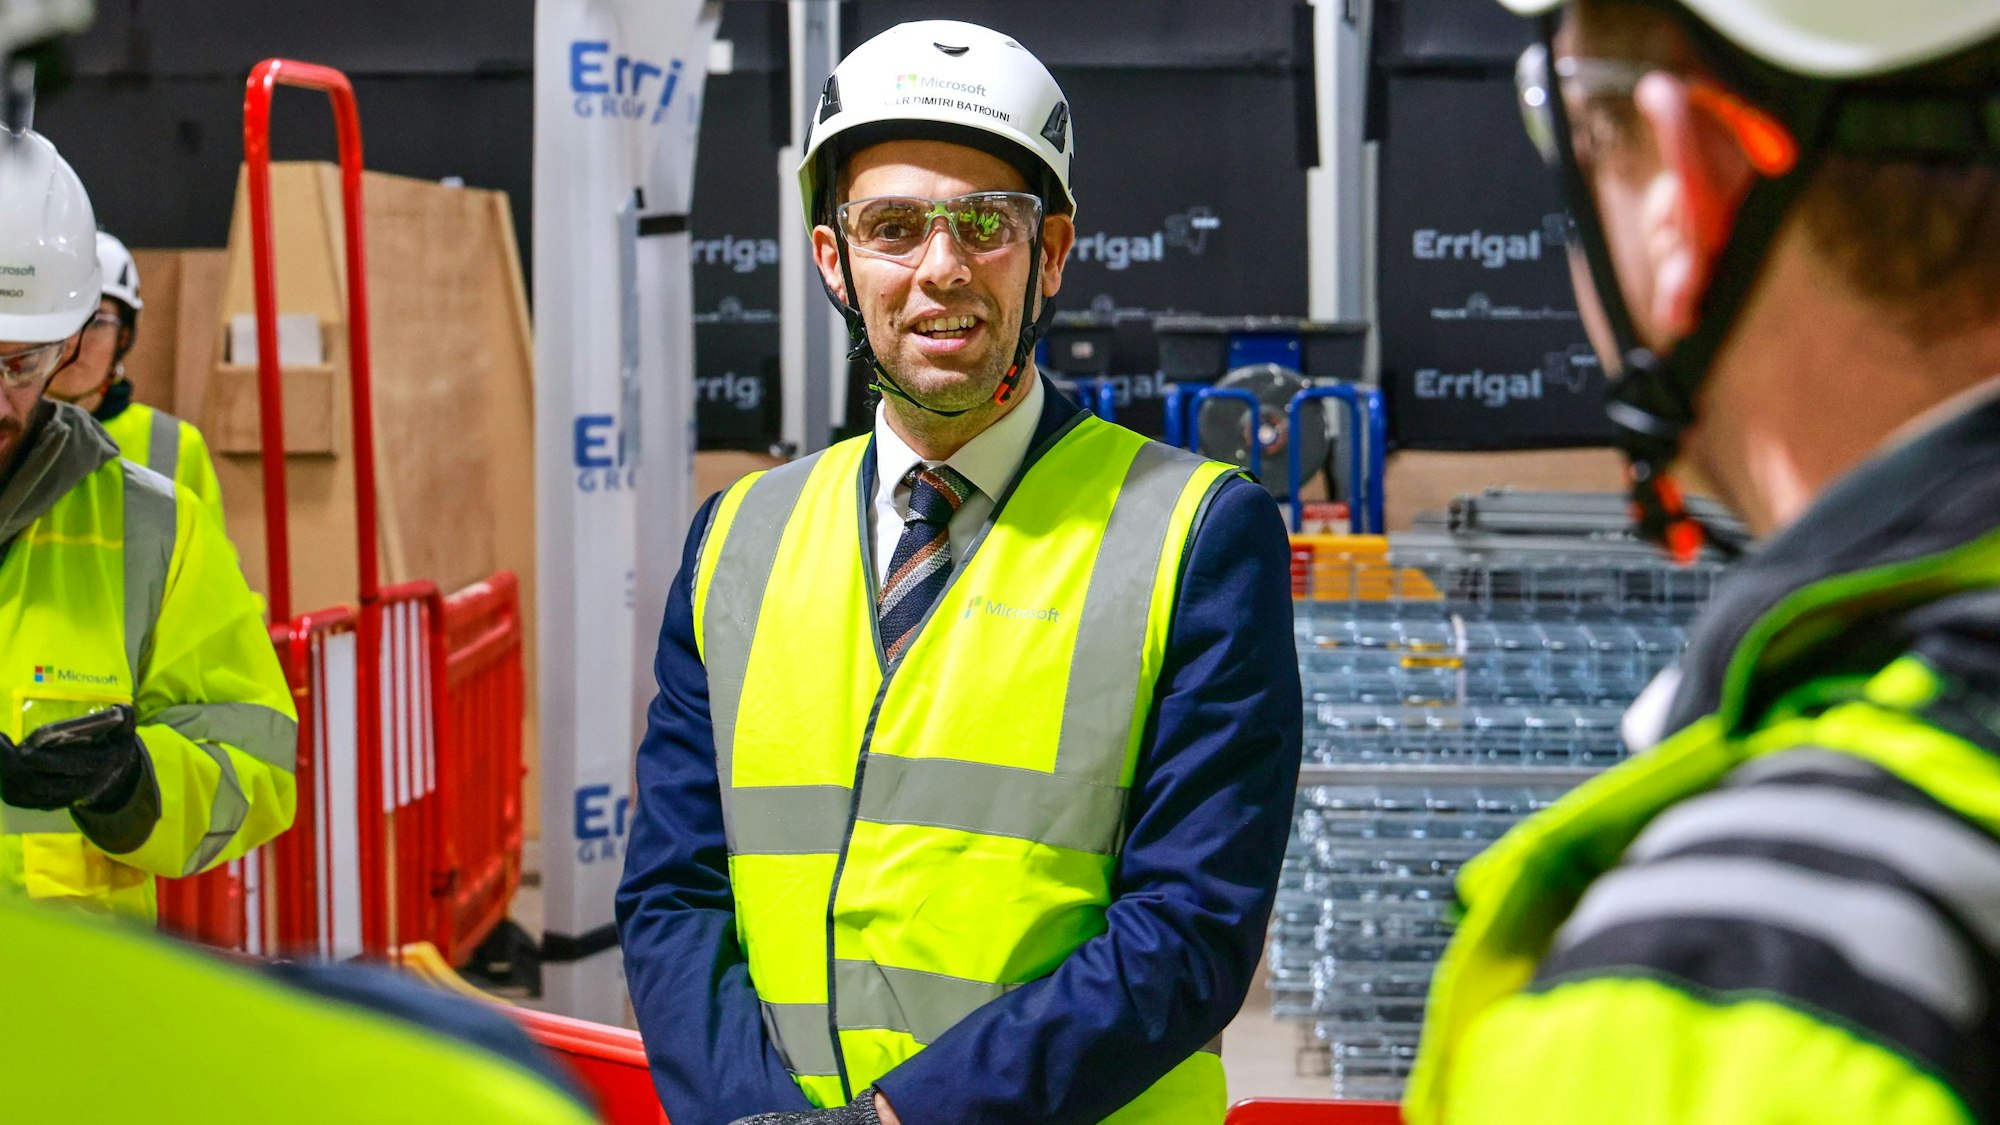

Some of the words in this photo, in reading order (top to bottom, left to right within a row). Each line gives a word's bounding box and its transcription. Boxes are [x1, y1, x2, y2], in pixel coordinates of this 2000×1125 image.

[920, 76, 987, 98] Microsoft
[913, 96, 954, 108] DIMITRI
[956, 100, 1011, 122] BATROUNI
[1412, 229, 1542, 269] Errigal
[1413, 367, 1543, 408] Errigal
[986, 600, 1060, 623] Microsoft
[57, 669, 119, 686] Microsoft
